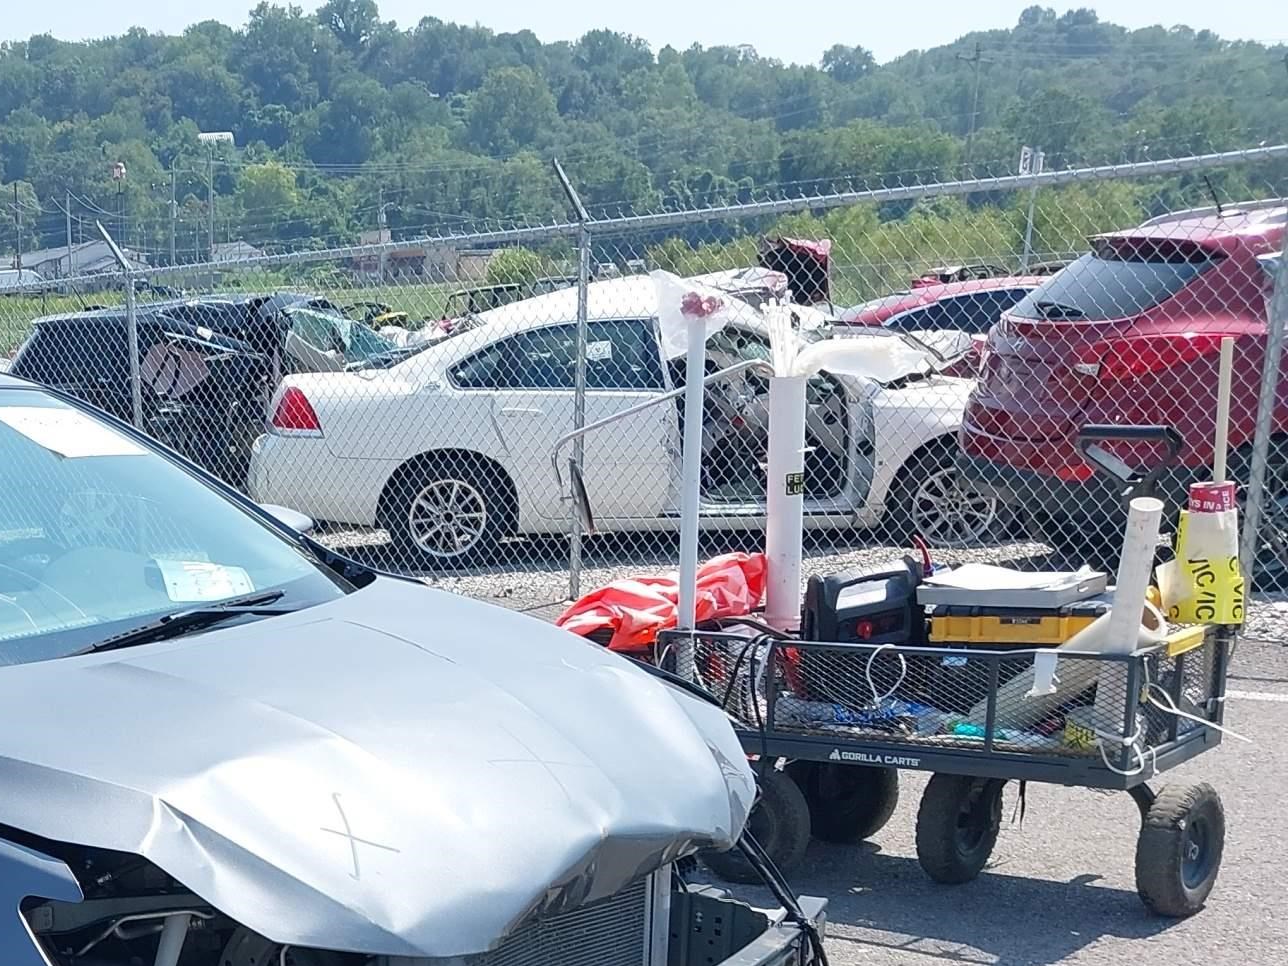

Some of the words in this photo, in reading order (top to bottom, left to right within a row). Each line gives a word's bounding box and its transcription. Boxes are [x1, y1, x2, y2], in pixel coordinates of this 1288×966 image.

[1202, 500, 1215, 510] IN
[841, 751, 882, 764] GORILLA
[884, 755, 920, 767] CARTS
